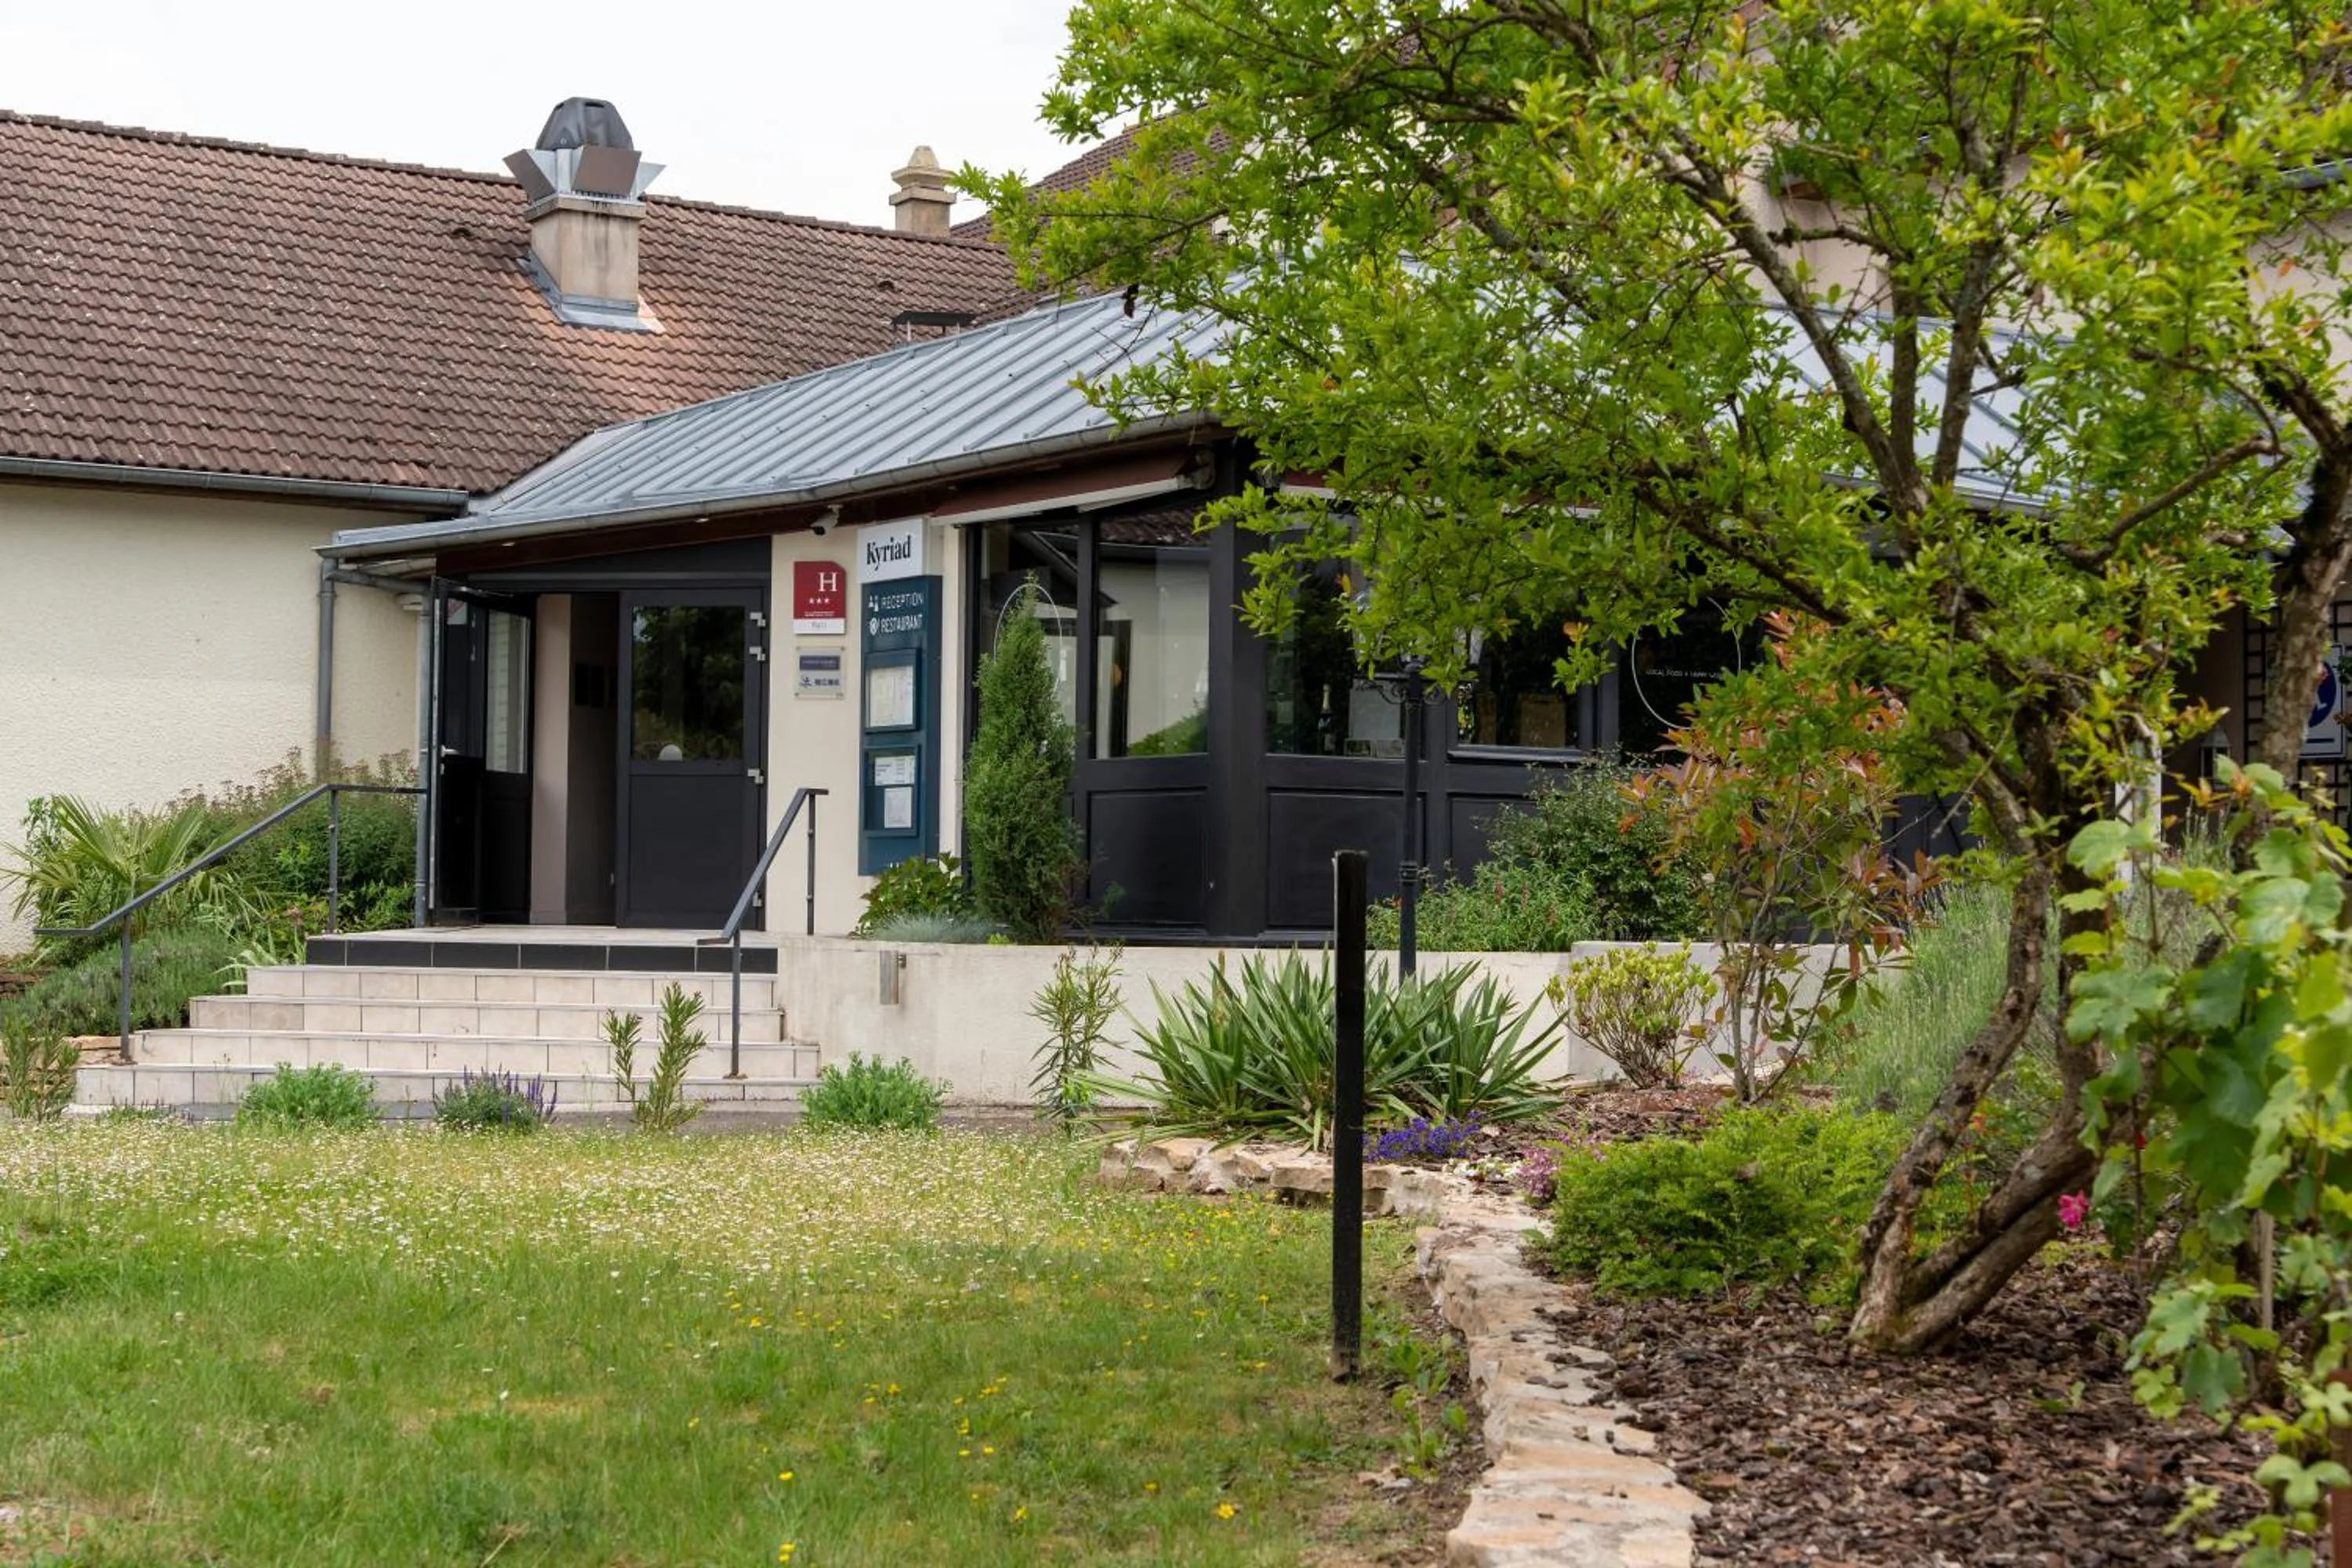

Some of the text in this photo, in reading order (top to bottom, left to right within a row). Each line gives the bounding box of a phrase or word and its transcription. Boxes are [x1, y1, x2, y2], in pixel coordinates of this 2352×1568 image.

[867, 535, 911, 572] Kyriad
[818, 572, 838, 592] H
[880, 592, 923, 609] RECEPTION
[880, 614, 923, 632] RESTAURANT
